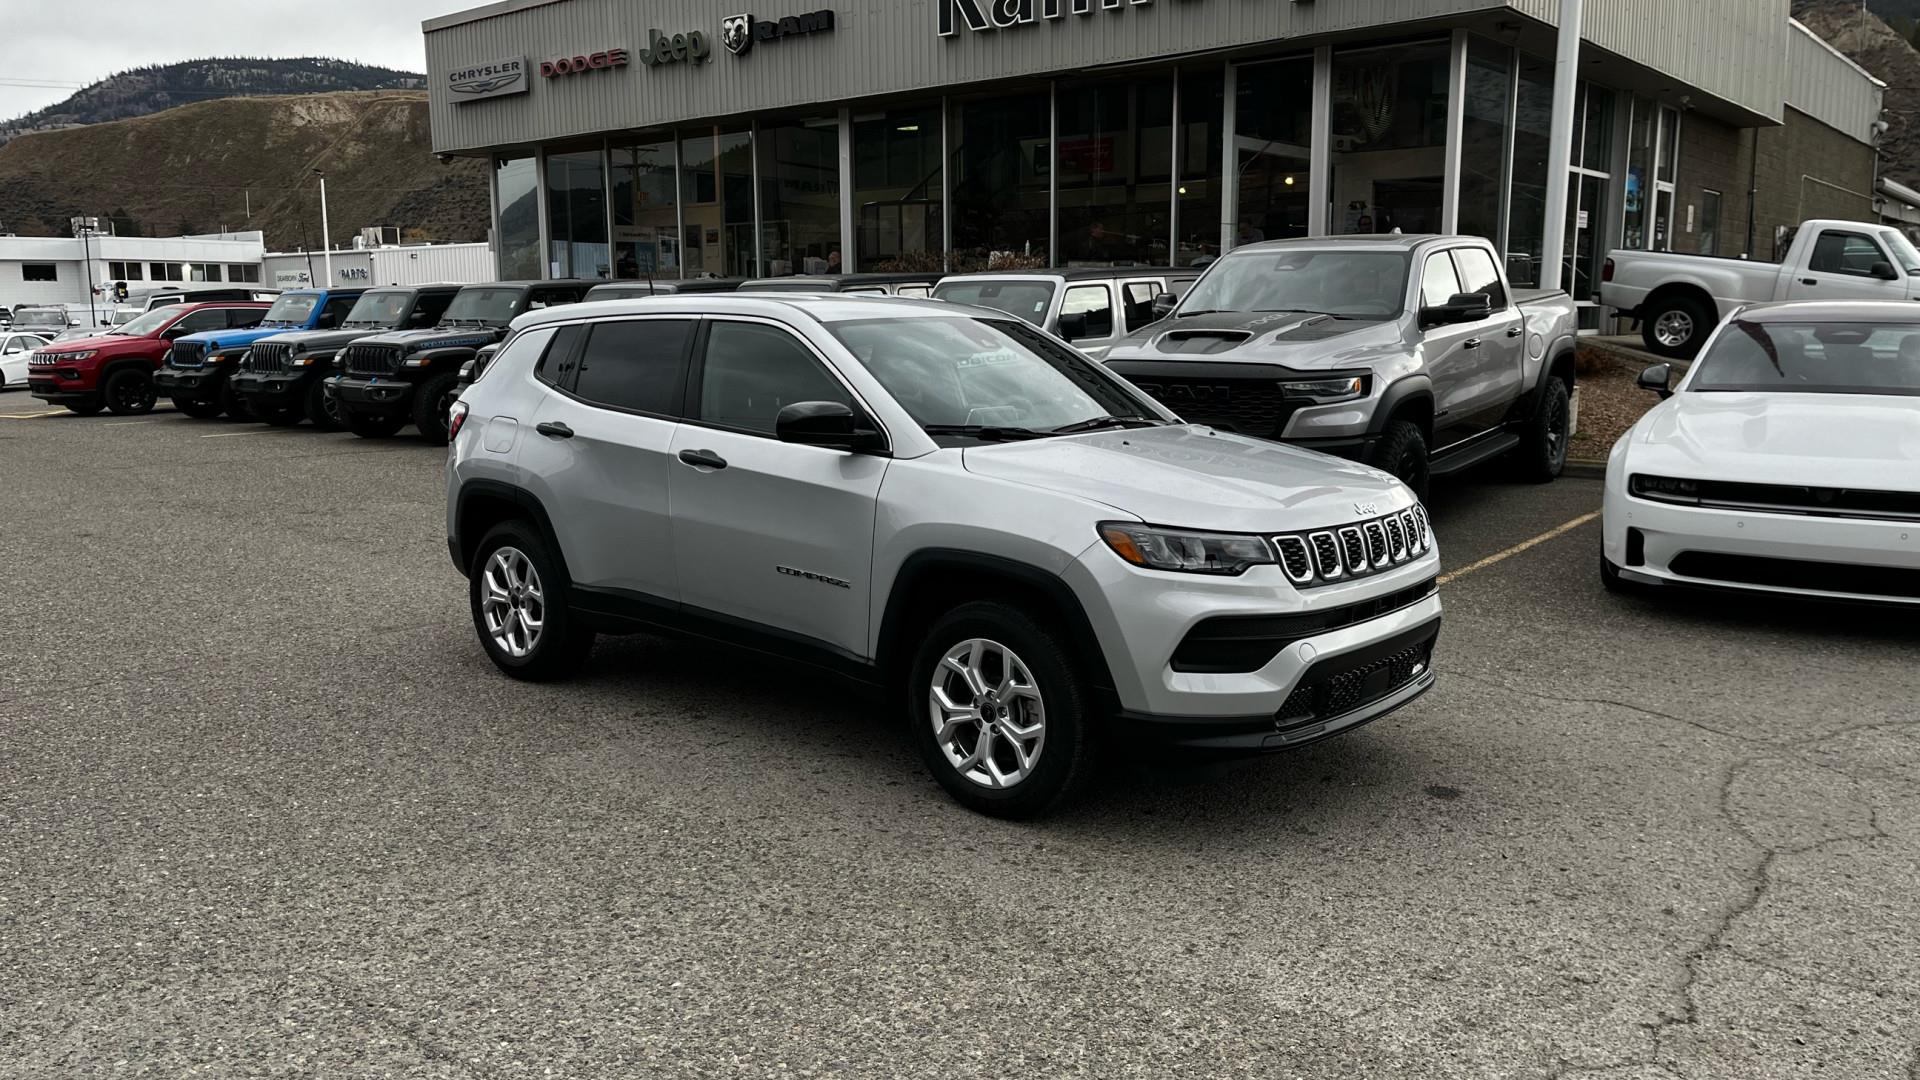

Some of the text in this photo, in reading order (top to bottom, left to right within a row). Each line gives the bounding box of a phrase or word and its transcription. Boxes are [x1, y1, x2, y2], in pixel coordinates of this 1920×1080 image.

[752, 10, 832, 41] RAM
[639, 29, 705, 65] Jeep
[449, 61, 520, 82] CHRYSLER
[540, 48, 627, 77] DODGE
[1353, 503, 1377, 515] Jeep
[776, 565, 850, 589] COMPASS
